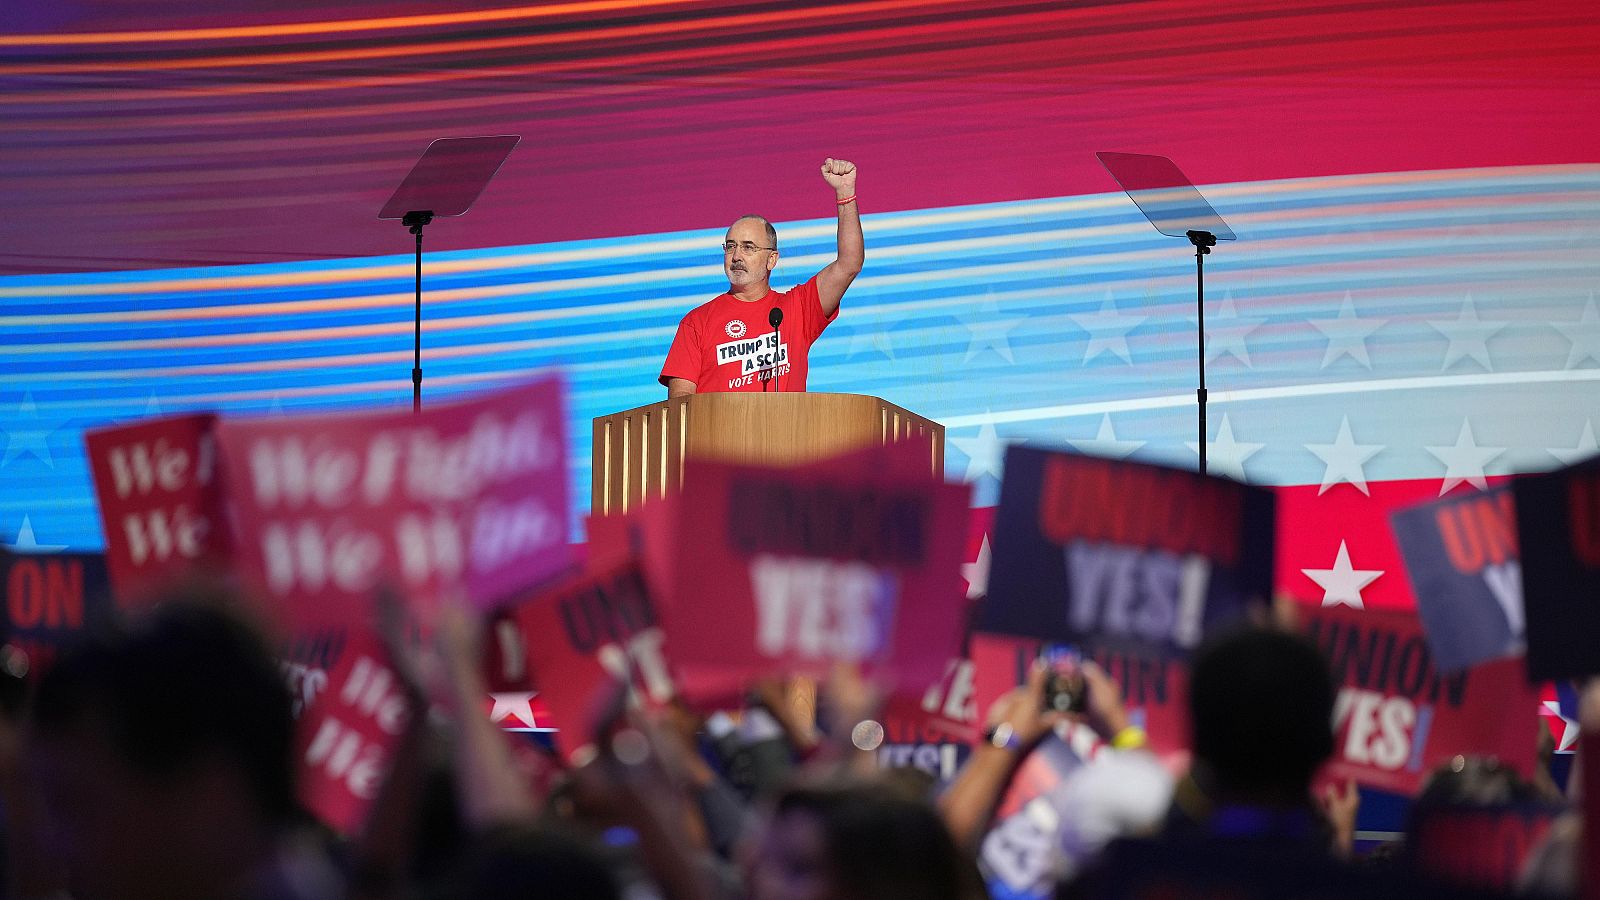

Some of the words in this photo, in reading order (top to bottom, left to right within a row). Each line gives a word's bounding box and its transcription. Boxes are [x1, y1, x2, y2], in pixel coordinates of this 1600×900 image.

[719, 339, 763, 360] TRUMP
[766, 334, 779, 349] IS
[745, 359, 754, 371] A
[757, 348, 786, 368] SCAB
[728, 373, 753, 389] VOTE
[757, 363, 791, 381] HARRIS
[108, 438, 190, 499] We
